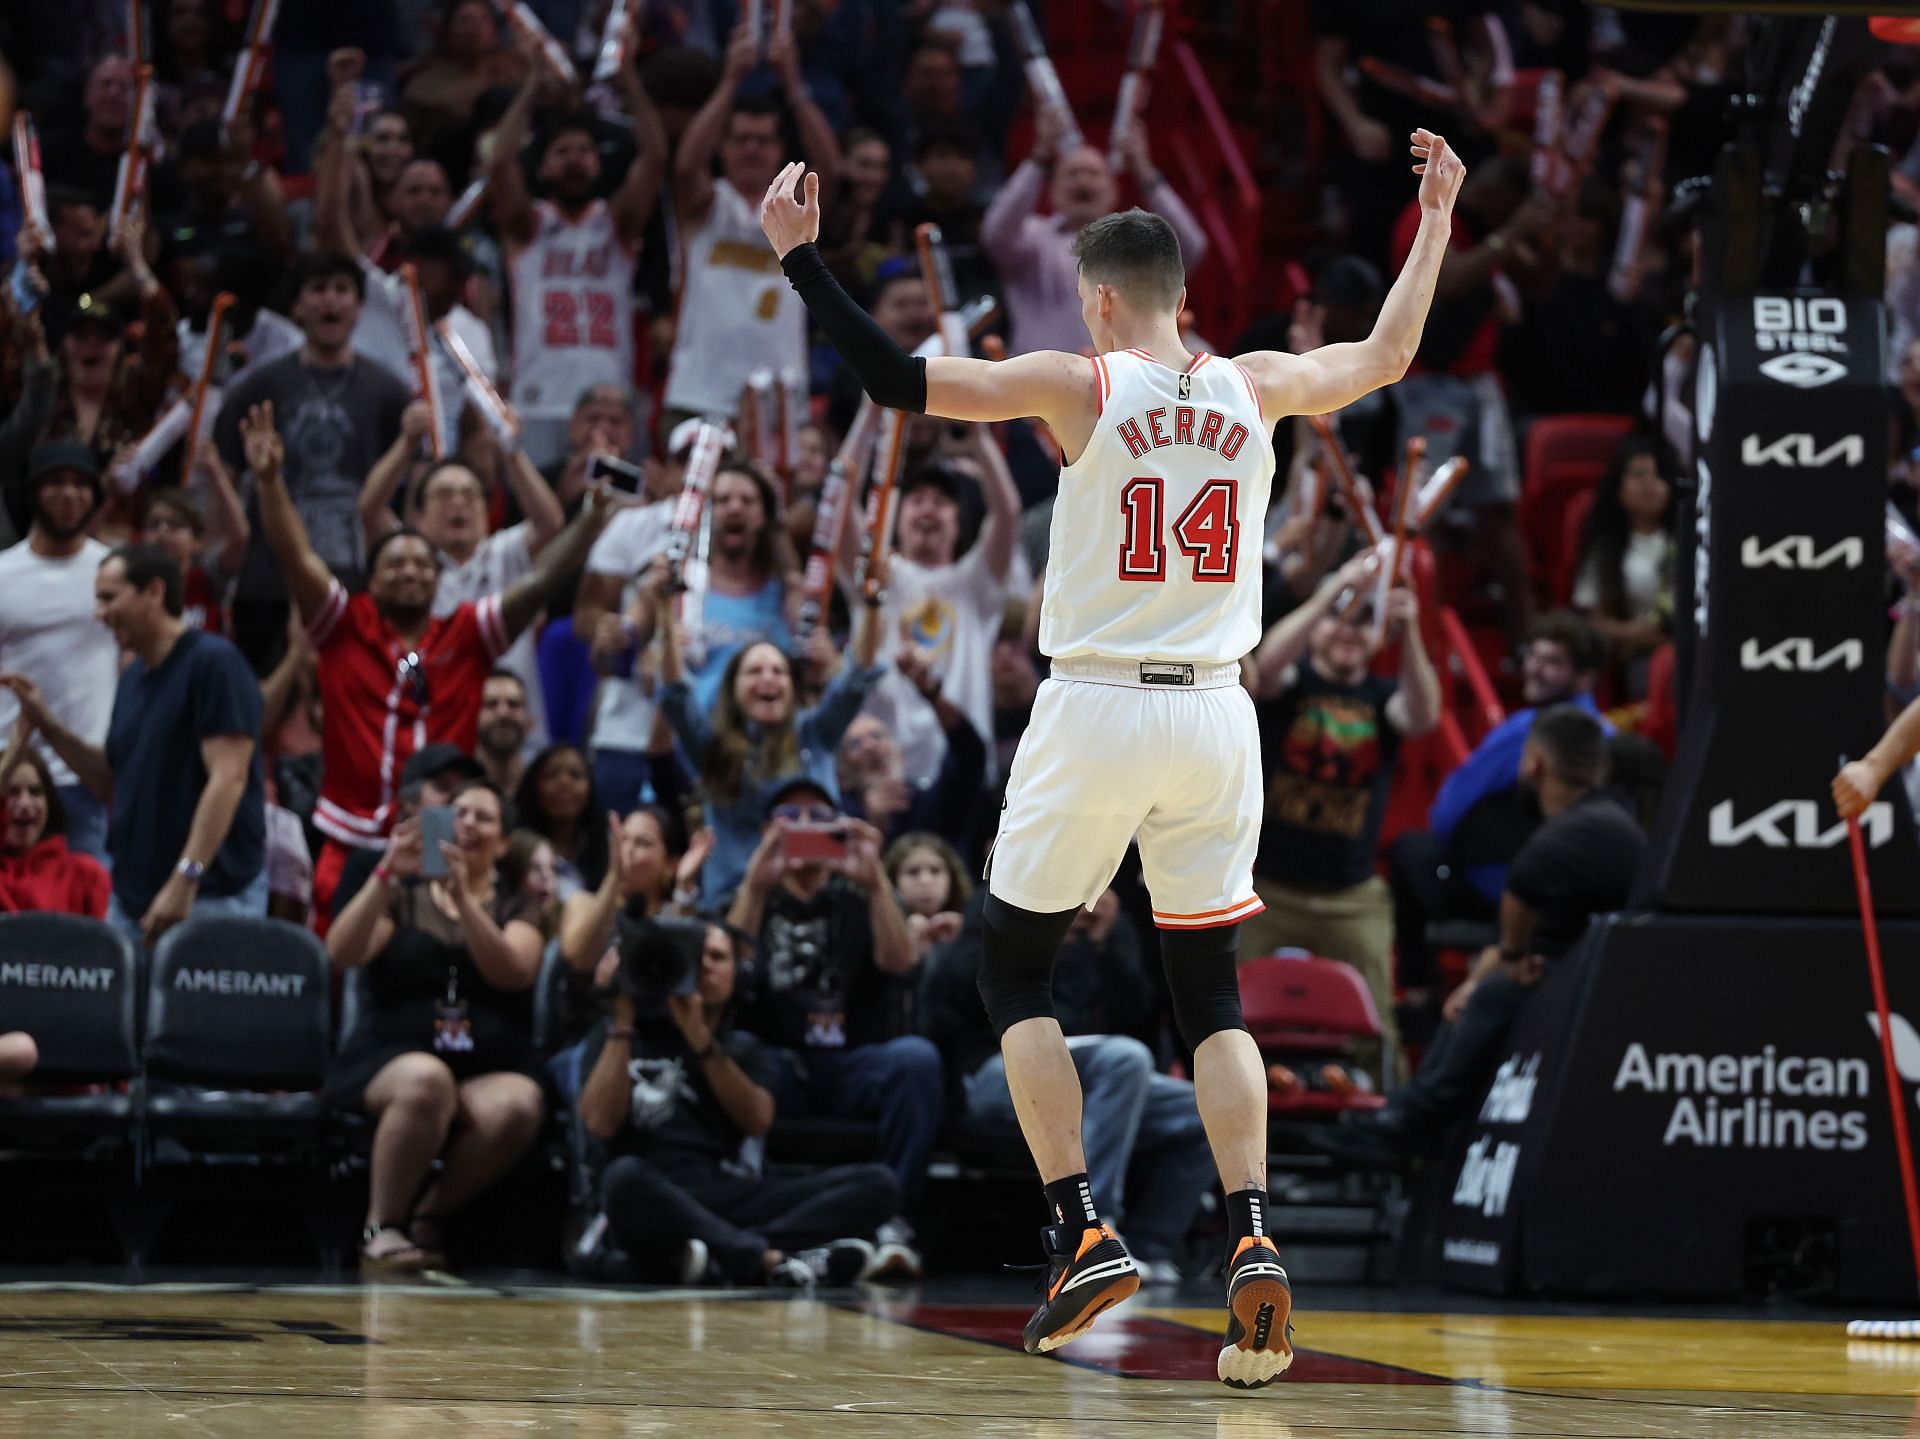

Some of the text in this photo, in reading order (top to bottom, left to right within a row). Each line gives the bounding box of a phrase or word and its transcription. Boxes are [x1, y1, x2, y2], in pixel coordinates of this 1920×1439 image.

[544, 289, 616, 348] 22
[1753, 296, 1847, 334] BIO
[1755, 331, 1848, 352] STEEL
[1117, 406, 1250, 461] HERRO
[1741, 432, 1864, 467] KIA
[1119, 477, 1240, 582] 14
[1741, 535, 1864, 570] KIA
[1740, 637, 1863, 672] KIA
[1709, 798, 1893, 848] KIA
[174, 967, 307, 995] AMERANT
[1613, 1042, 1870, 1097] American
[1663, 1097, 1869, 1150] Airlines
